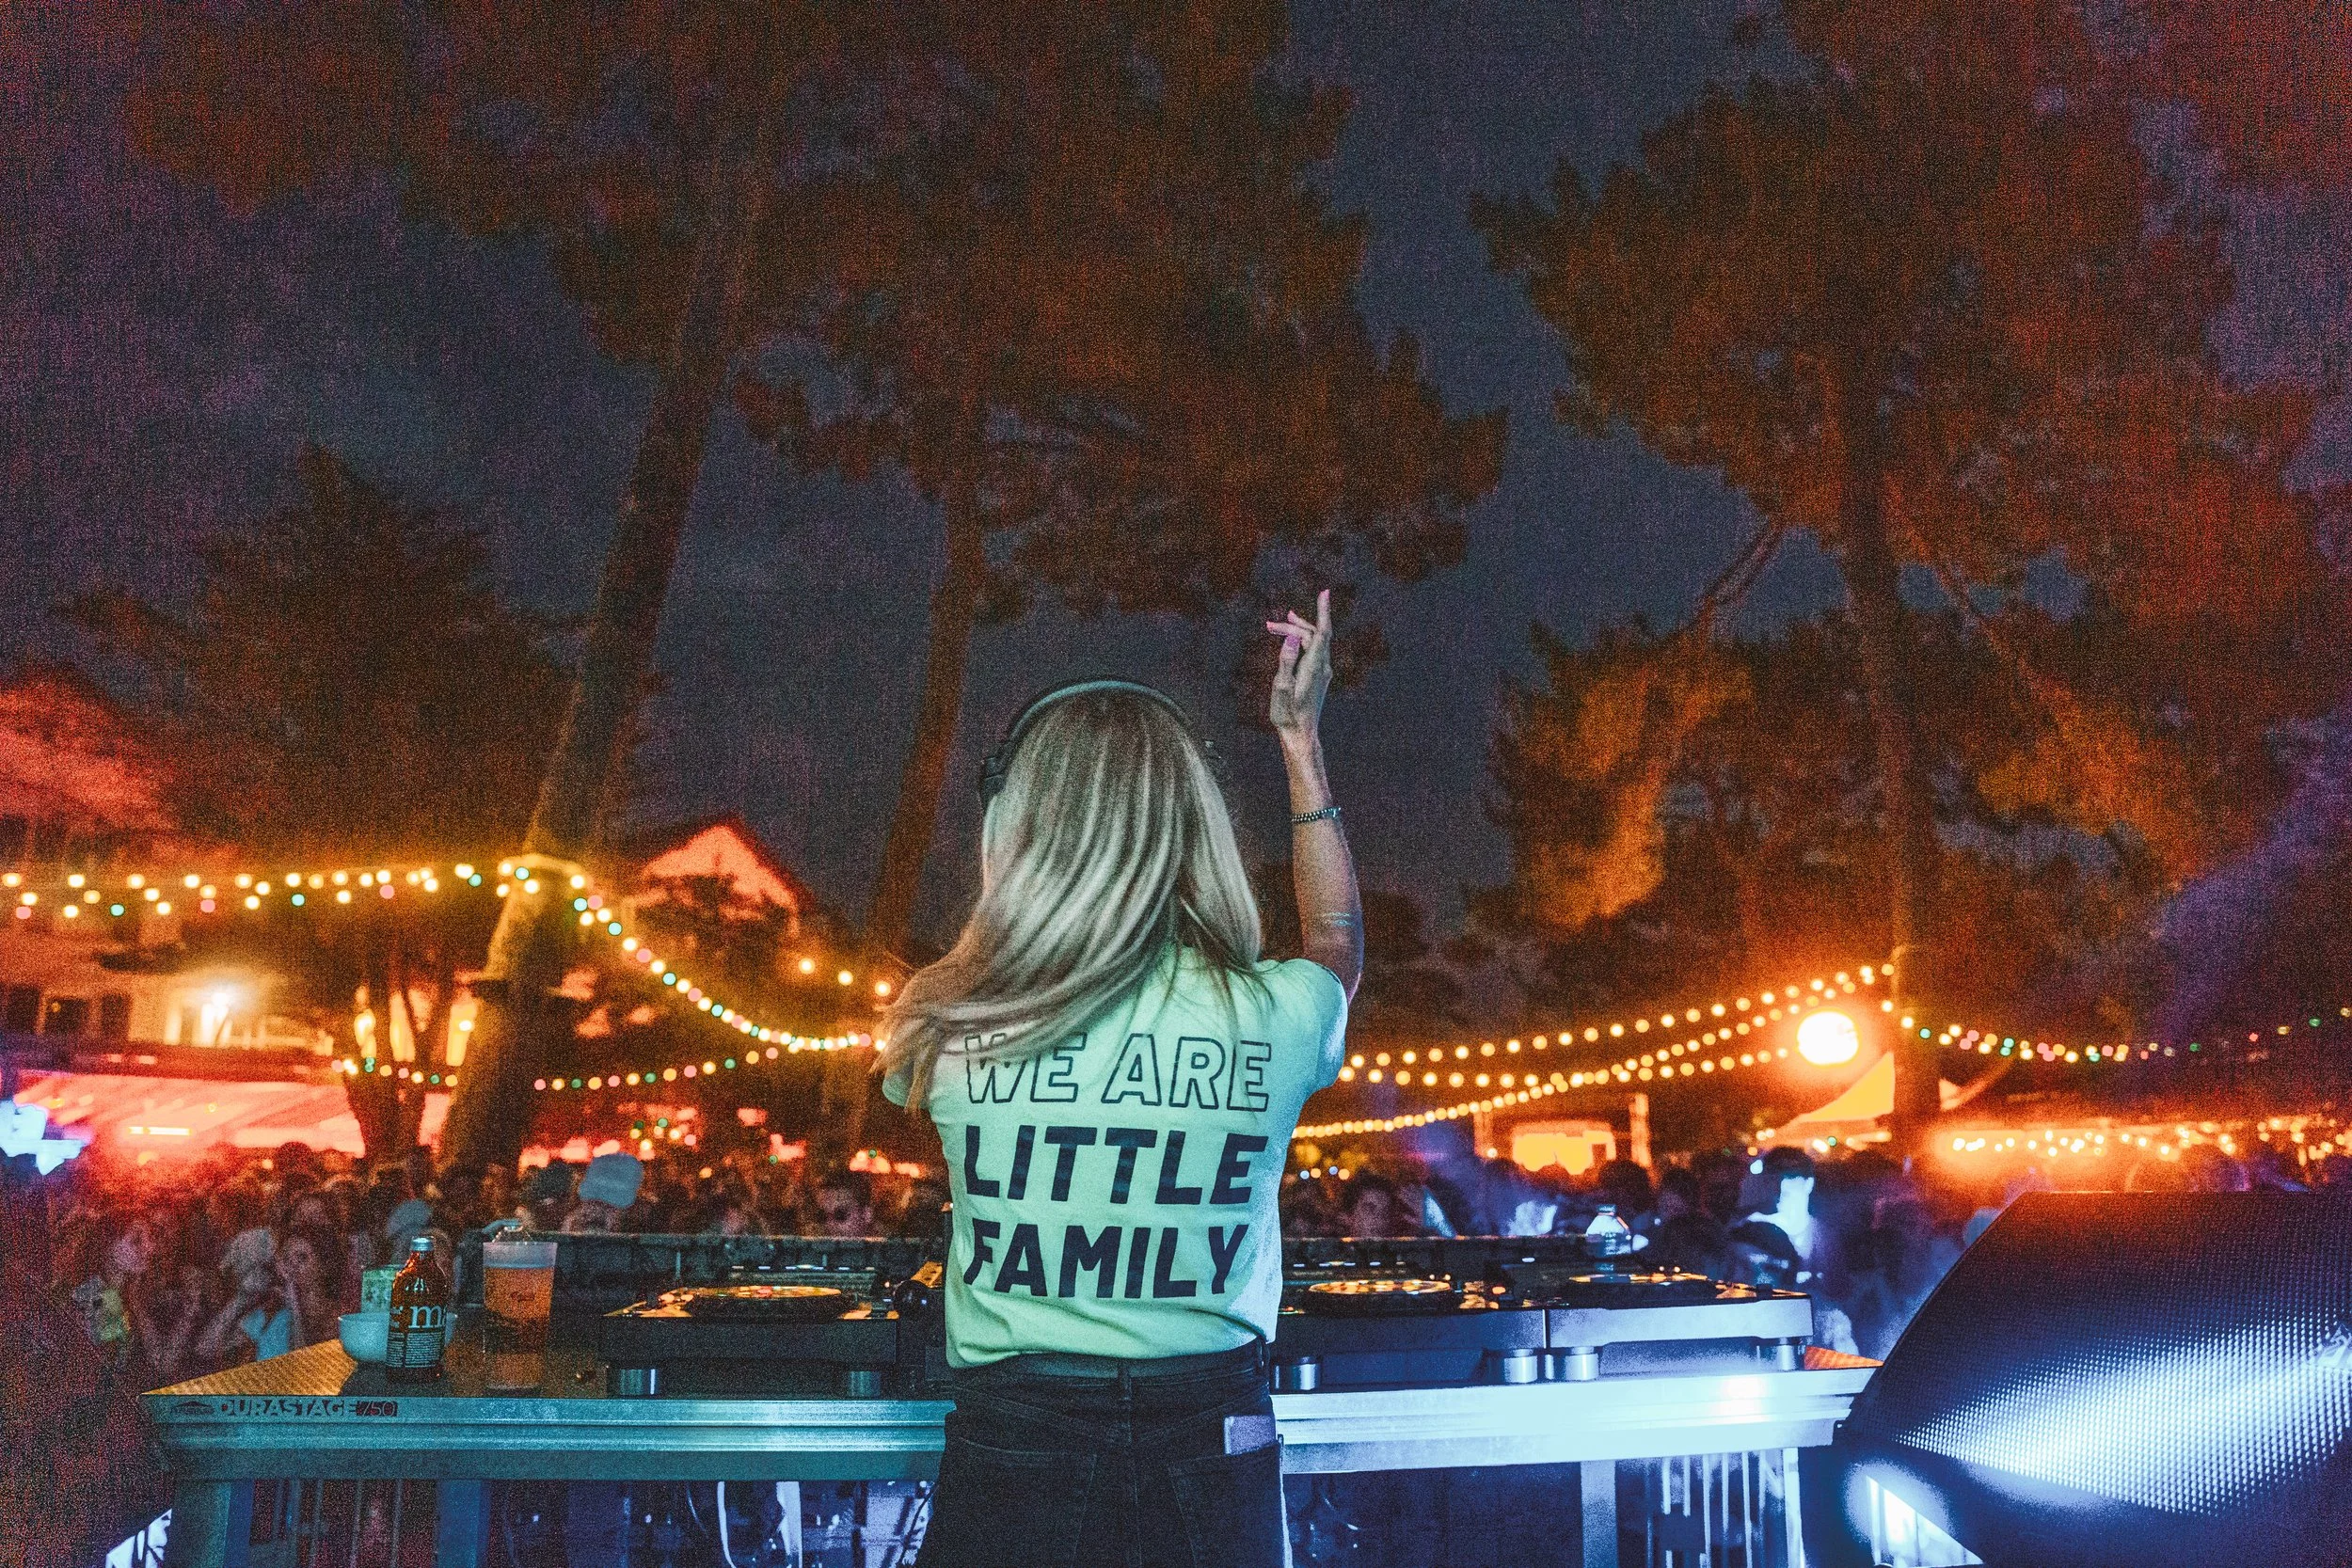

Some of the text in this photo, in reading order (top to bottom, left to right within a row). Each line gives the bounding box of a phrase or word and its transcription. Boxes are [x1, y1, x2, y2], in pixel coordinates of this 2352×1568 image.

[964, 1032, 1272, 1112] WE ARE
[964, 1125, 1268, 1205] LITTLE
[962, 1219, 1248, 1298] FAMILY
[219, 1399, 356, 1417] DURASTAGE
[358, 1401, 398, 1418] 750
